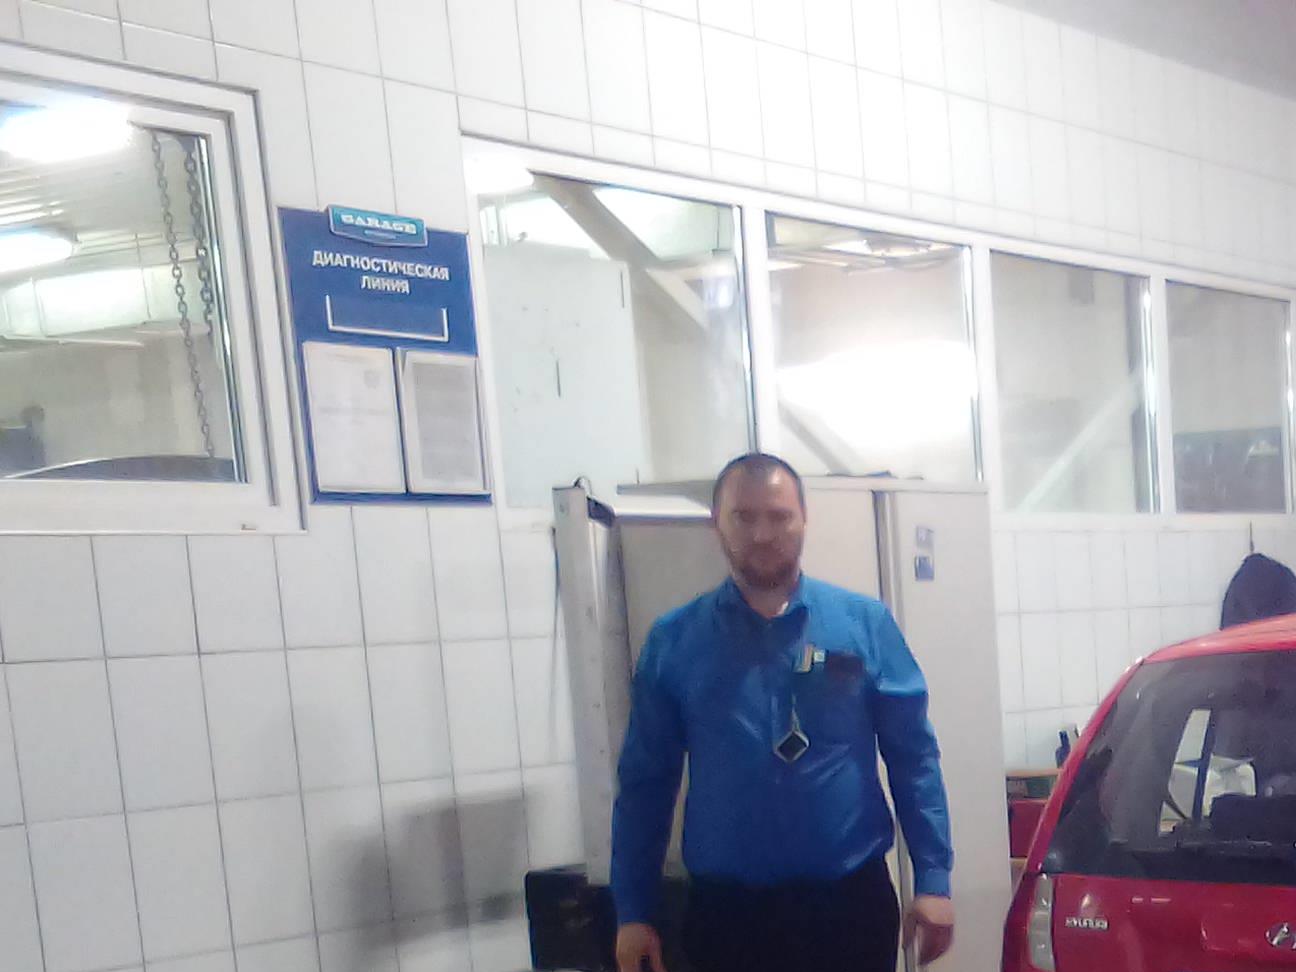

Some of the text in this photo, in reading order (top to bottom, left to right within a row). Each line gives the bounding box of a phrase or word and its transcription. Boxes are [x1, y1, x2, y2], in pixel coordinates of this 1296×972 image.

[341, 214, 417, 235] GARAGE
[312, 249, 450, 281] ДИАГНОСТИЧЕСКАЯ
[360, 275, 411, 294] ЛИНИЯ
